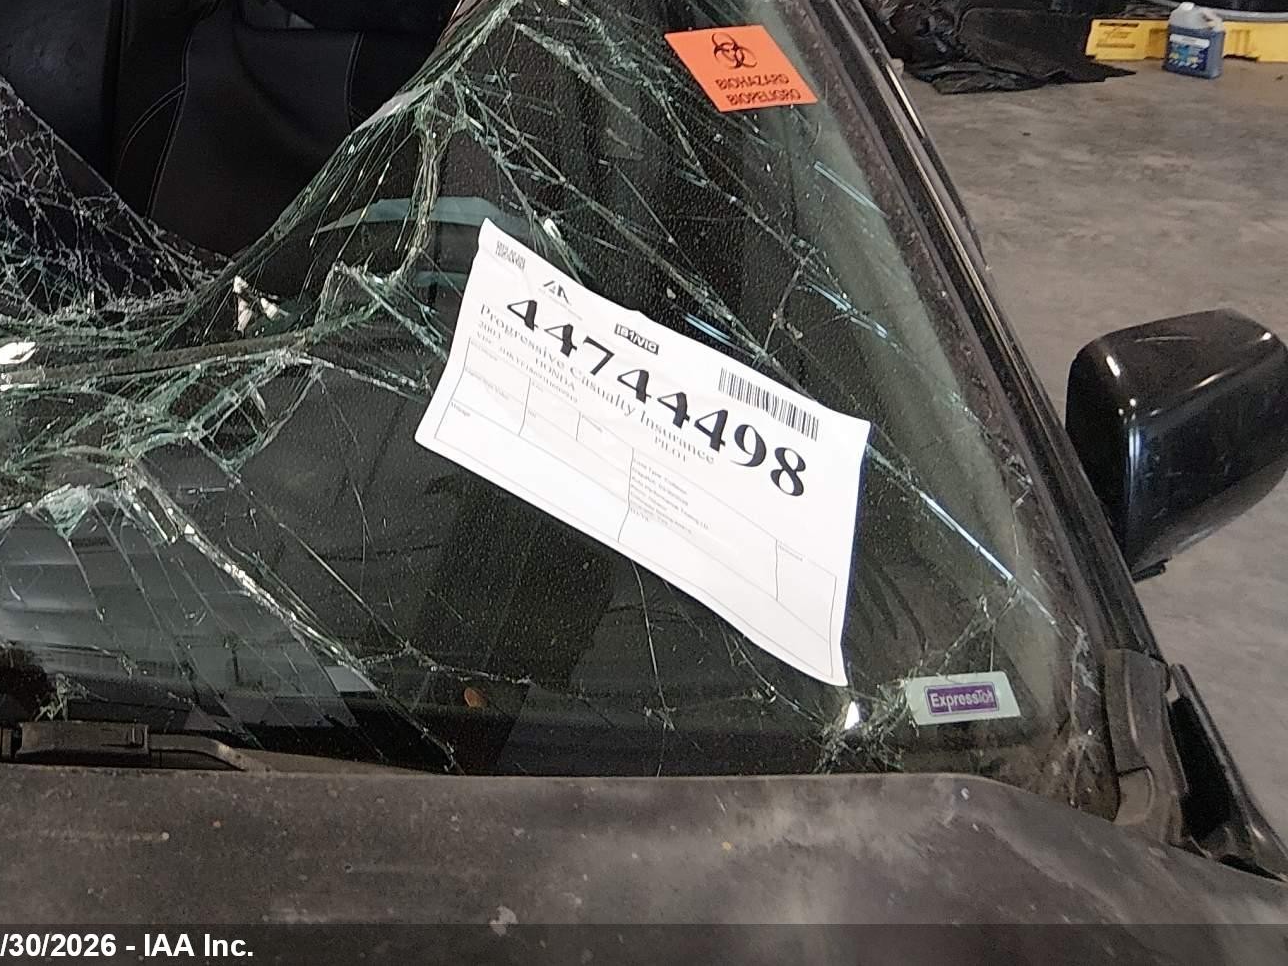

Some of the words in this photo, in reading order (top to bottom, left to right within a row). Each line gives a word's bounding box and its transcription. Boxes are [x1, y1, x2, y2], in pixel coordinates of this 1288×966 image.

[714, 73, 790, 91] BIOHAZARD
[725, 88, 801, 106] BIOPELIGRO
[479, 302, 566, 370] Progressive
[570, 366, 637, 417] Casualty
[640, 409, 715, 465] Insurance
[506, 298, 807, 497] 44744498
